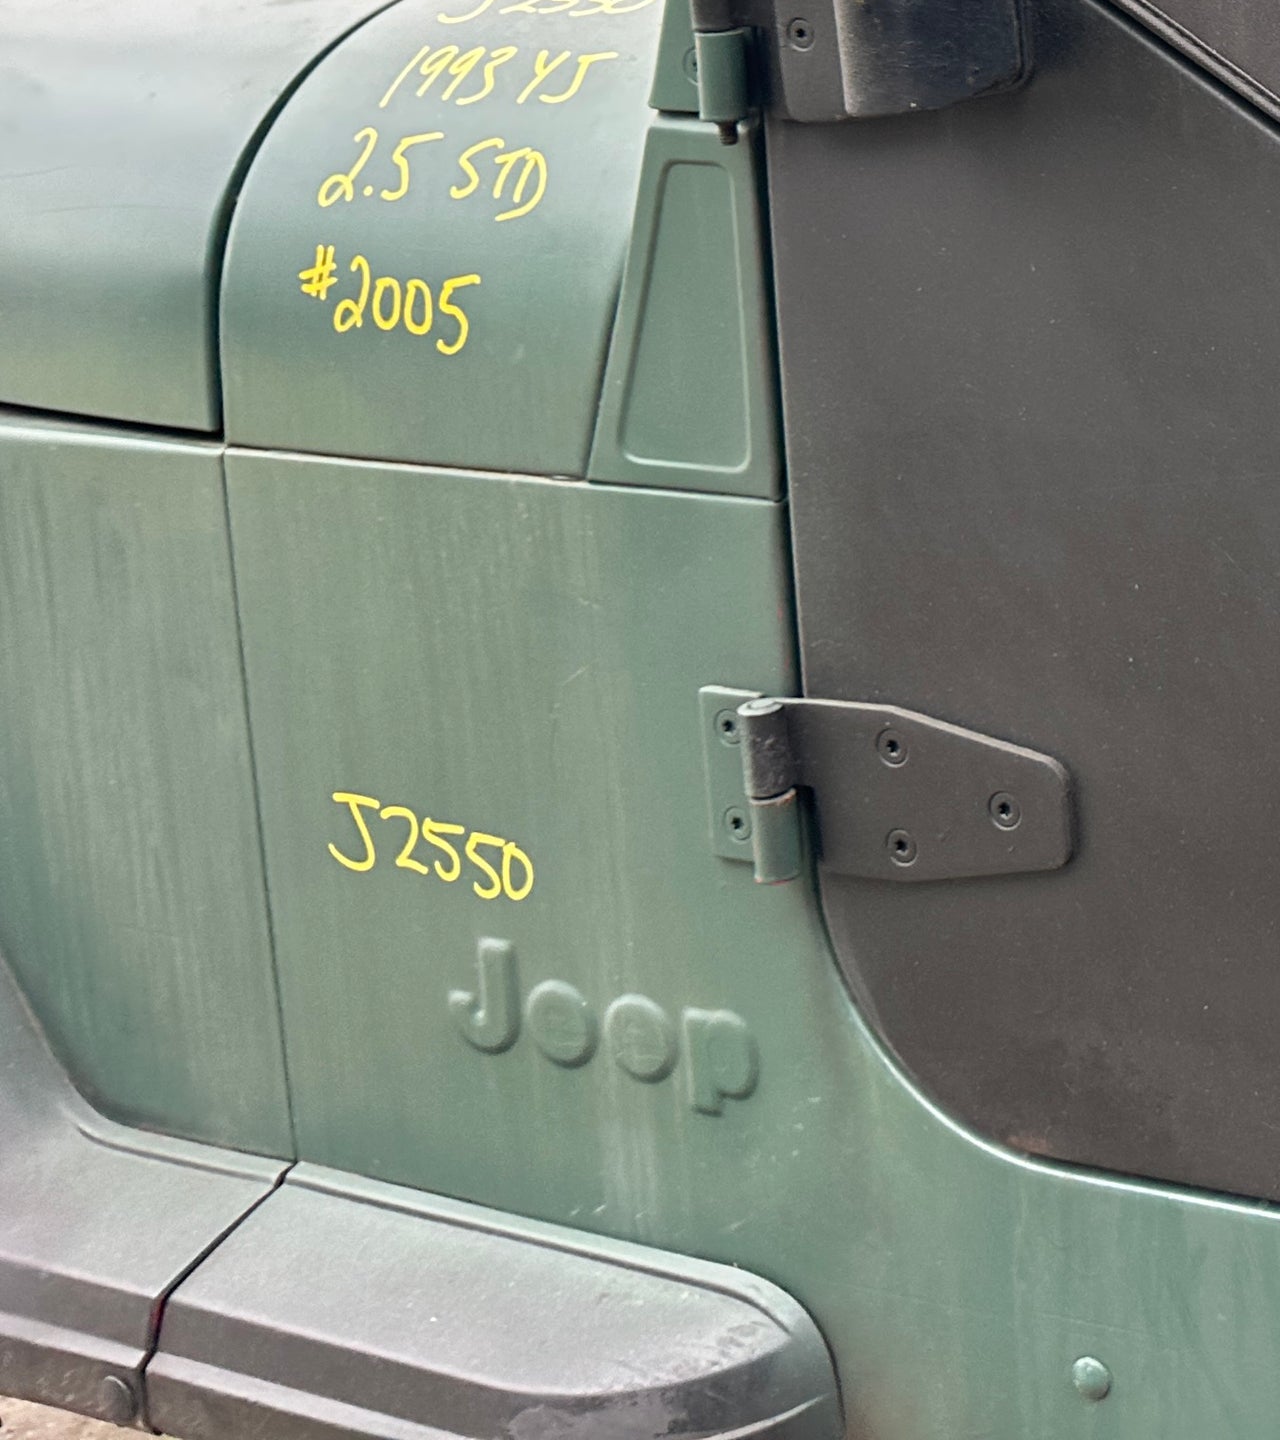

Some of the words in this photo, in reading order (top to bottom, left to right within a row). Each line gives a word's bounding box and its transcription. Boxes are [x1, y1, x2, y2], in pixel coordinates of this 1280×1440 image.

[380, 45, 518, 107] 1993
[516, 49, 619, 104] YJ
[318, 127, 443, 207] 2.5
[450, 137, 548, 221] STD
[299, 244, 482, 356] #2005
[327, 791, 535, 902] J2550
[449, 936, 760, 1118] Jeep
